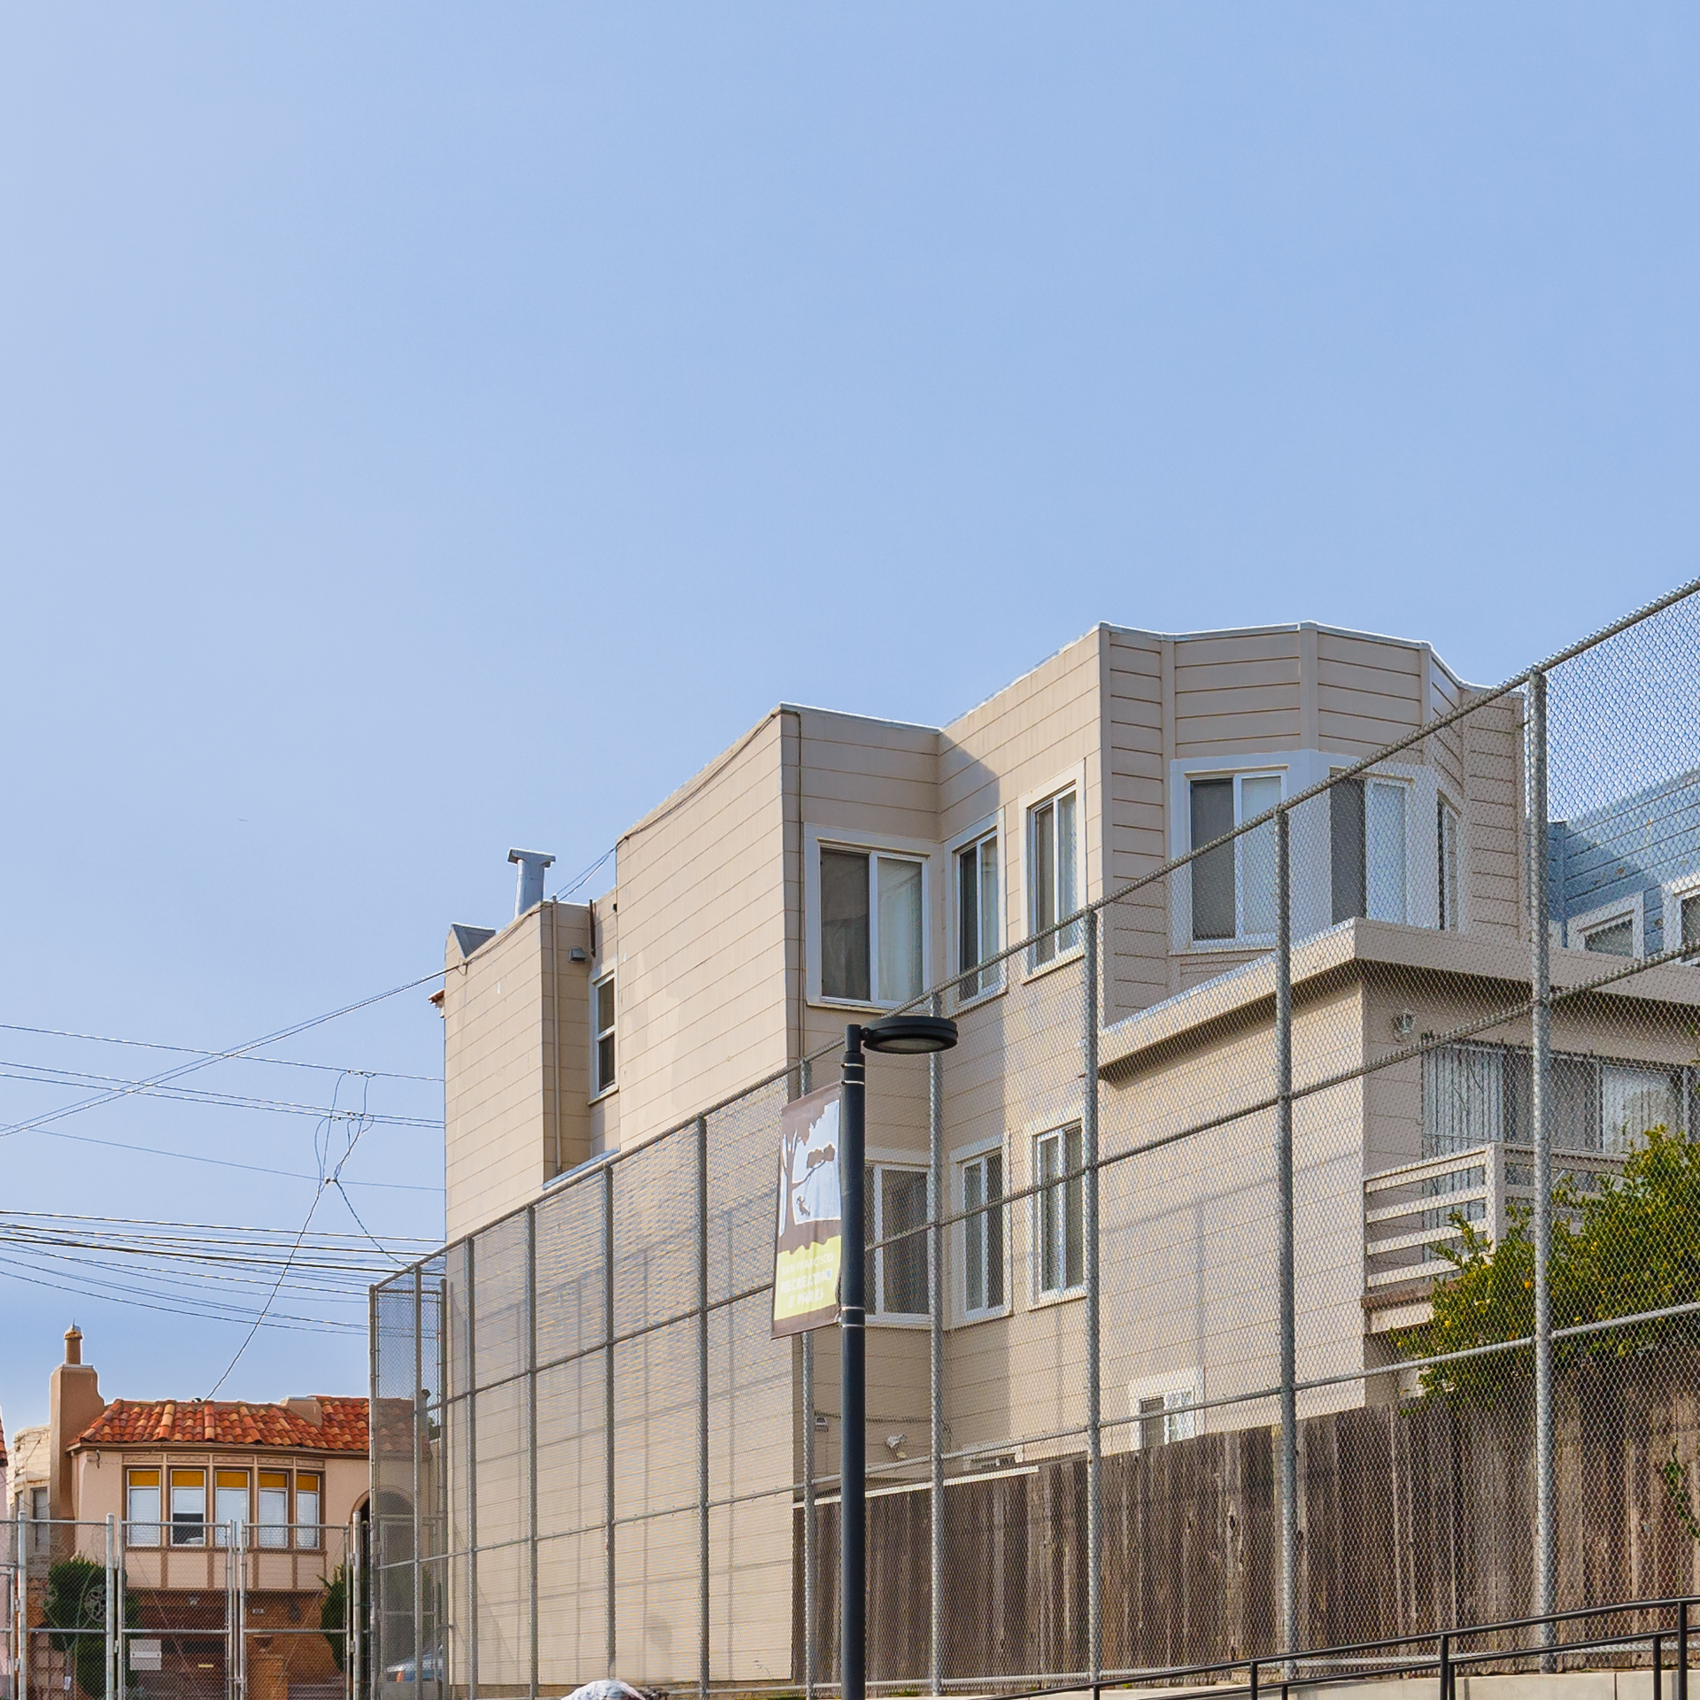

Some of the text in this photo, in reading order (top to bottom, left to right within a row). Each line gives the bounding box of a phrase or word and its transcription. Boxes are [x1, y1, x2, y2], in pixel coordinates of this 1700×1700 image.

[781, 1264, 795, 1276] SAN
[780, 1268, 832, 1293] RECREATION
[797, 1287, 825, 1306] PARKS
